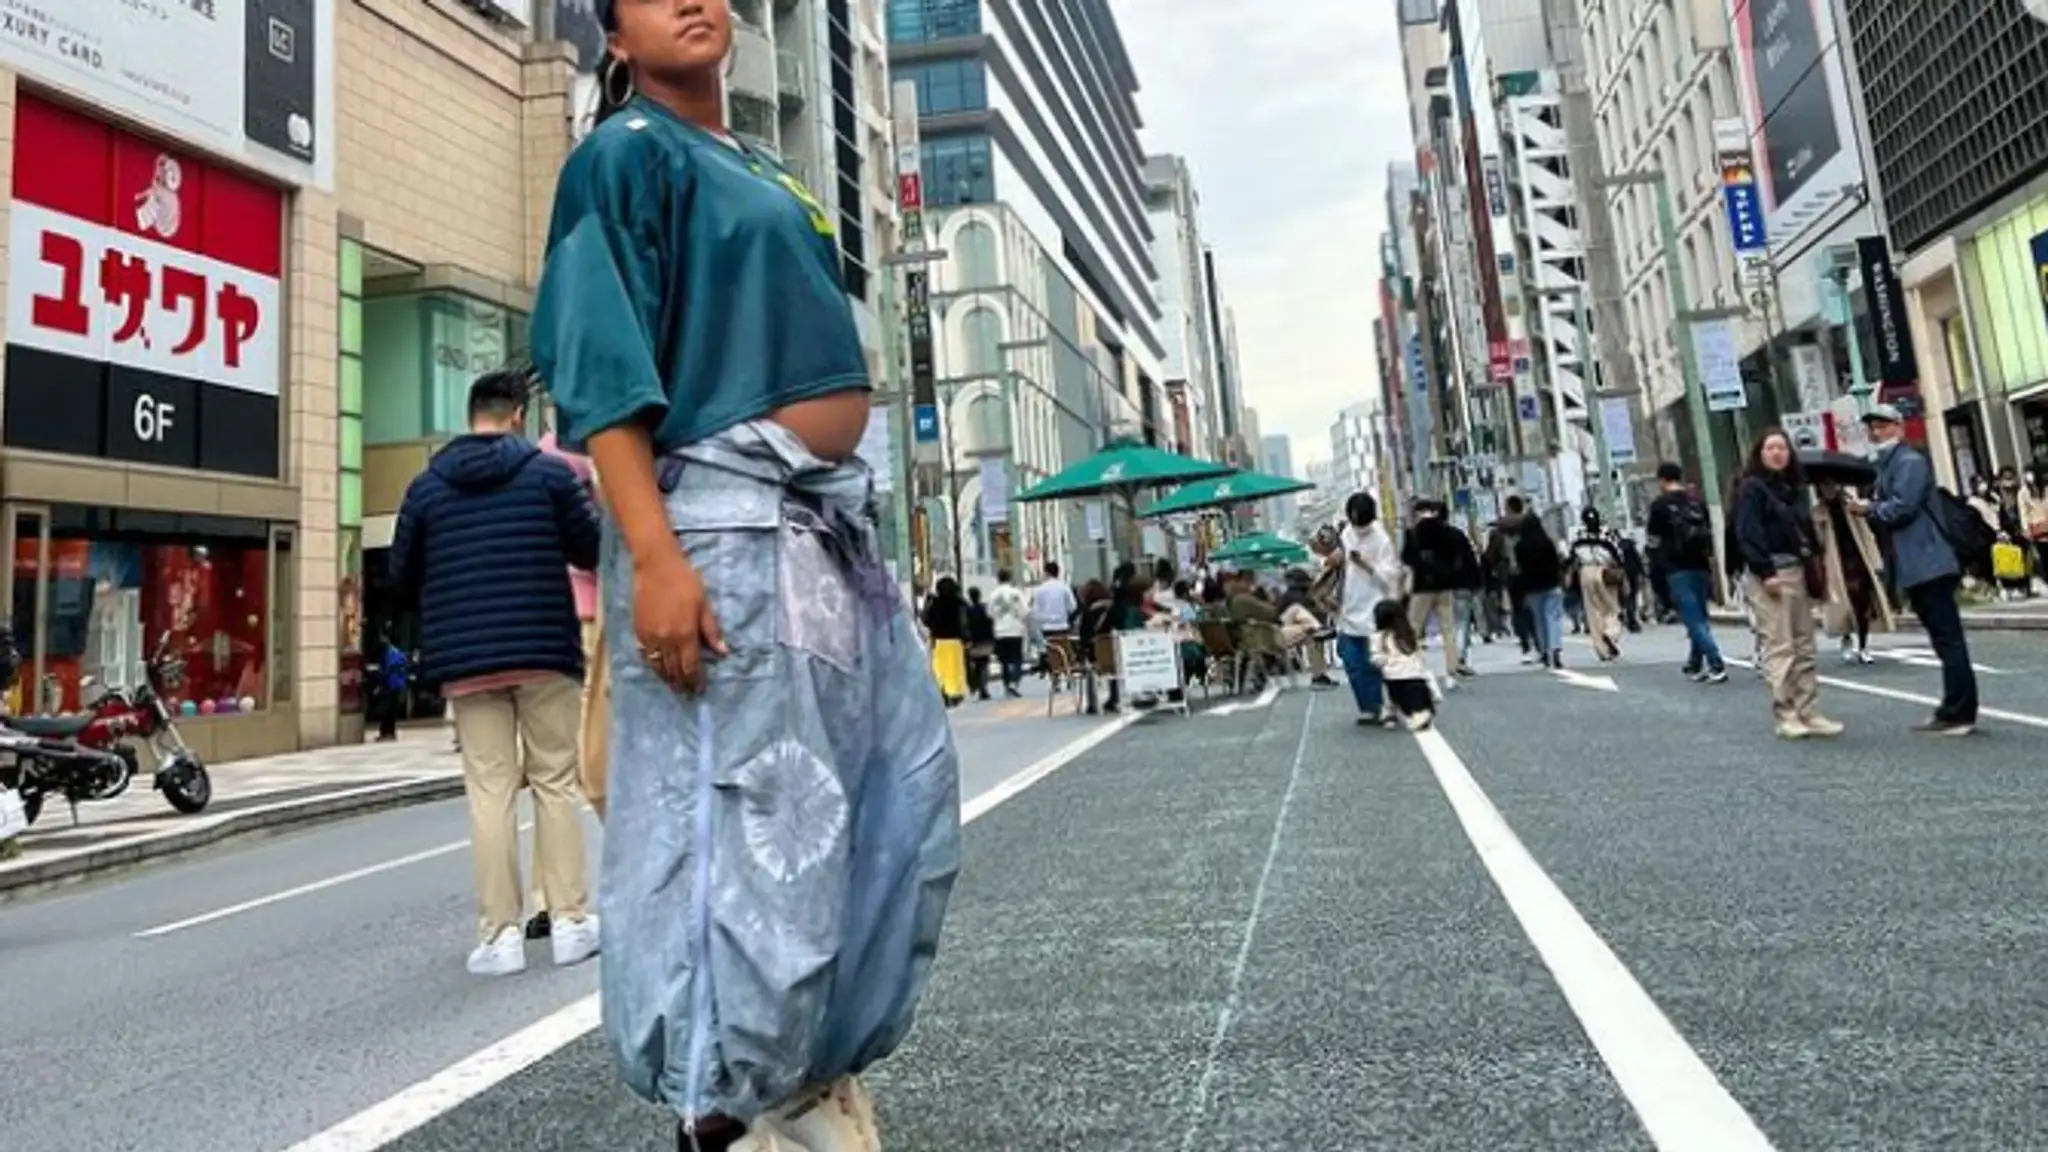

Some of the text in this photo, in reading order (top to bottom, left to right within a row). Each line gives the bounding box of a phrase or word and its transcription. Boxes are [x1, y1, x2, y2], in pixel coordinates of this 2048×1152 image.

[57, 35, 104, 69] CARD
[1733, 188, 1756, 243] PLAZA
[32, 229, 259, 368] ユザワヤ
[133, 393, 175, 442] 6F
